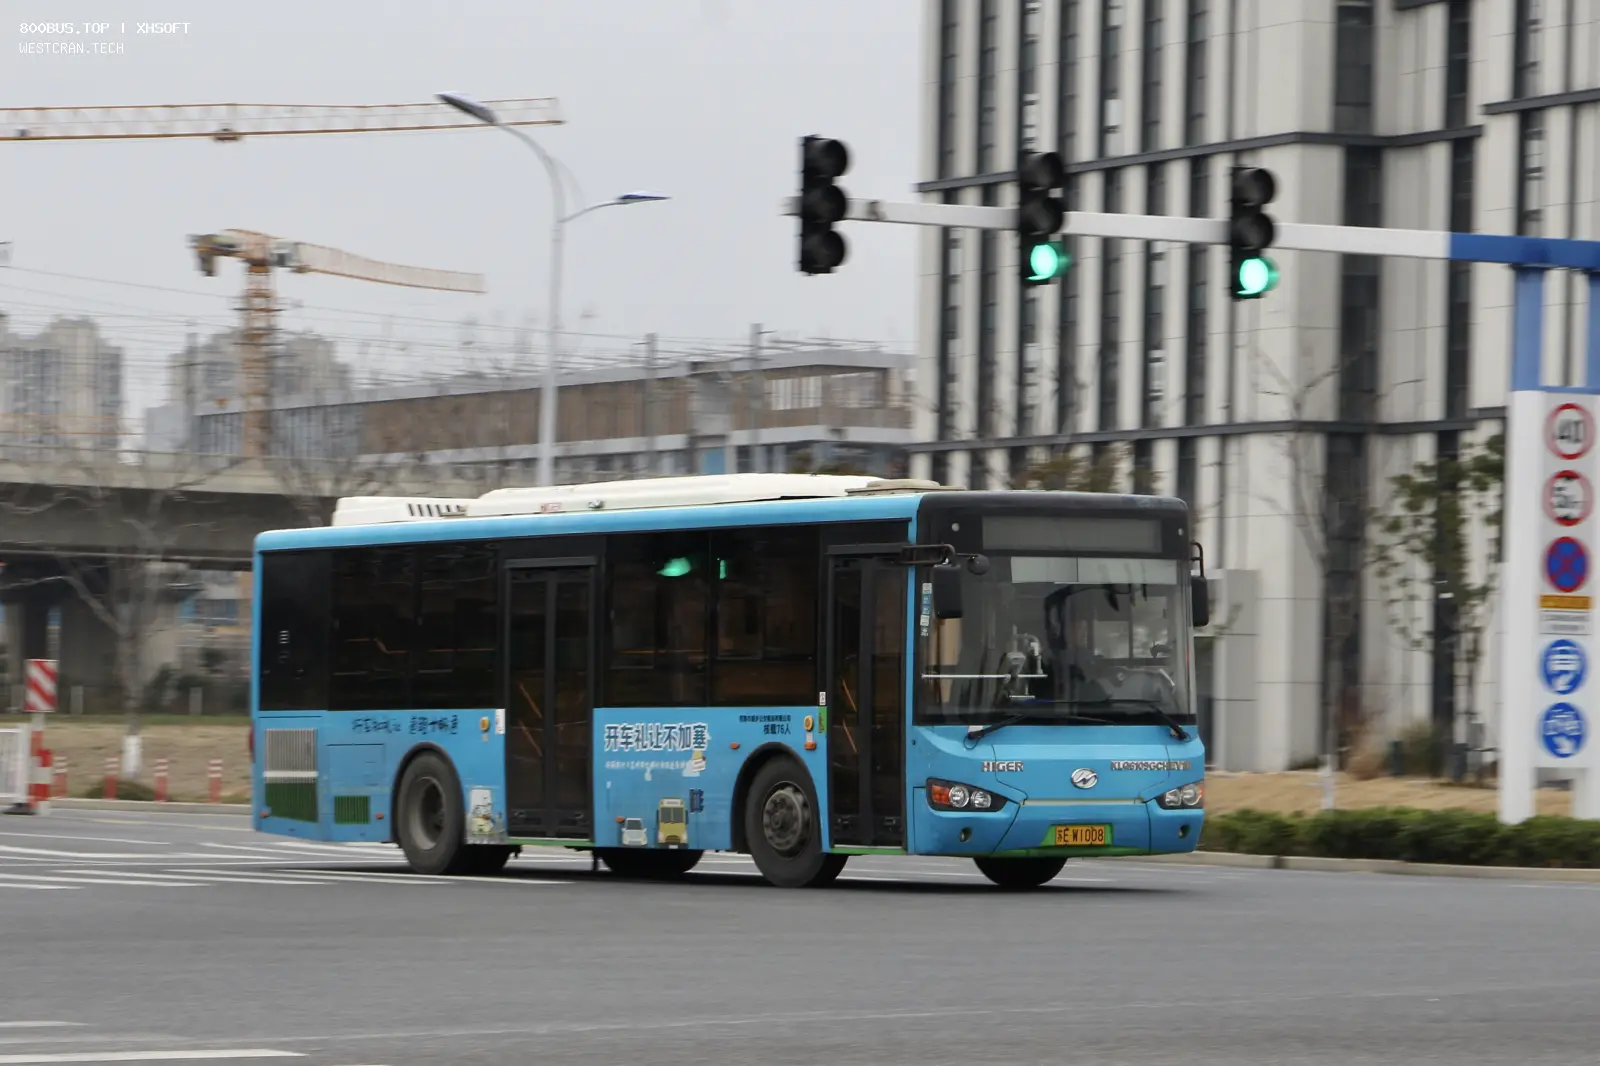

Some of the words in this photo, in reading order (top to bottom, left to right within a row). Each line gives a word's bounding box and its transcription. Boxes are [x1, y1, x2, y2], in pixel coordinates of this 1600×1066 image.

[604, 723, 708, 752] 开车礼让不加塞
[981, 760, 1024, 772] HIGER
